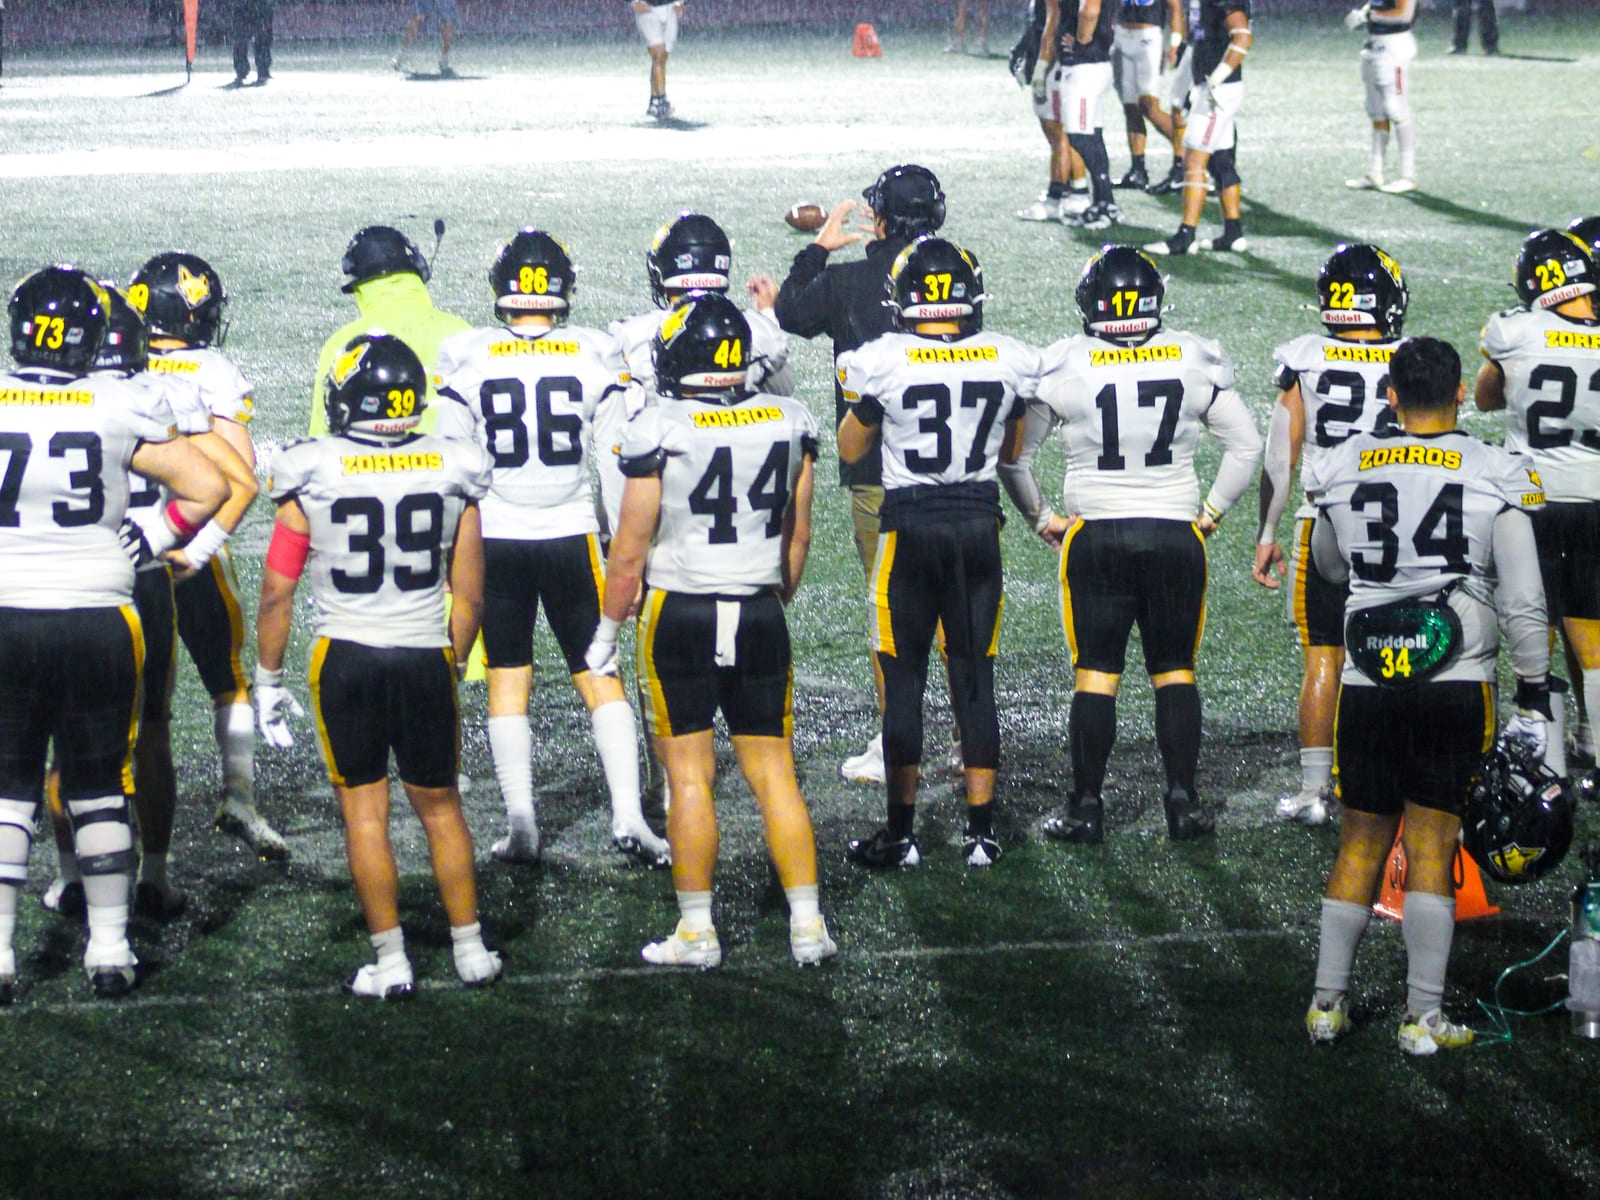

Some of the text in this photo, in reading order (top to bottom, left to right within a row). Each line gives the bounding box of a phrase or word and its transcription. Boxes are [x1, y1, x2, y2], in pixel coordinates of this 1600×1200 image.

[519, 266, 548, 294] 86
[681, 277, 721, 288] Riddell
[924, 273, 952, 302] 37
[1535, 259, 1566, 292] 23
[1111, 290, 1139, 317] 17
[1329, 282, 1355, 309] 22
[1539, 287, 1581, 308] Riddell
[919, 306, 963, 317] Riddell
[1324, 312, 1361, 323] Riddell
[34, 315, 65, 349] 73
[1104, 321, 1148, 333] Riddell
[1545, 330, 1600, 350] ZORR
[488, 340, 580, 358] ZORROS
[714, 338, 742, 369] 44
[905, 345, 998, 365] ZORROS
[1089, 344, 1183, 367] ZORROS
[1323, 346, 1397, 363] ZORRO
[386, 388, 416, 418] 39
[480, 376, 583, 468] 86
[689, 407, 784, 428] ZORROS
[902, 380, 1005, 474] 37
[1095, 378, 1184, 470] 17
[340, 453, 444, 476] ZORROS
[1359, 445, 1463, 471] ZORROS
[0, 431, 105, 527] 73
[688, 441, 790, 544] 44
[330, 492, 446, 593] 39
[1350, 482, 1472, 582] 34
[1366, 635, 1430, 650] Riddell
[1380, 648, 1412, 679] 34
